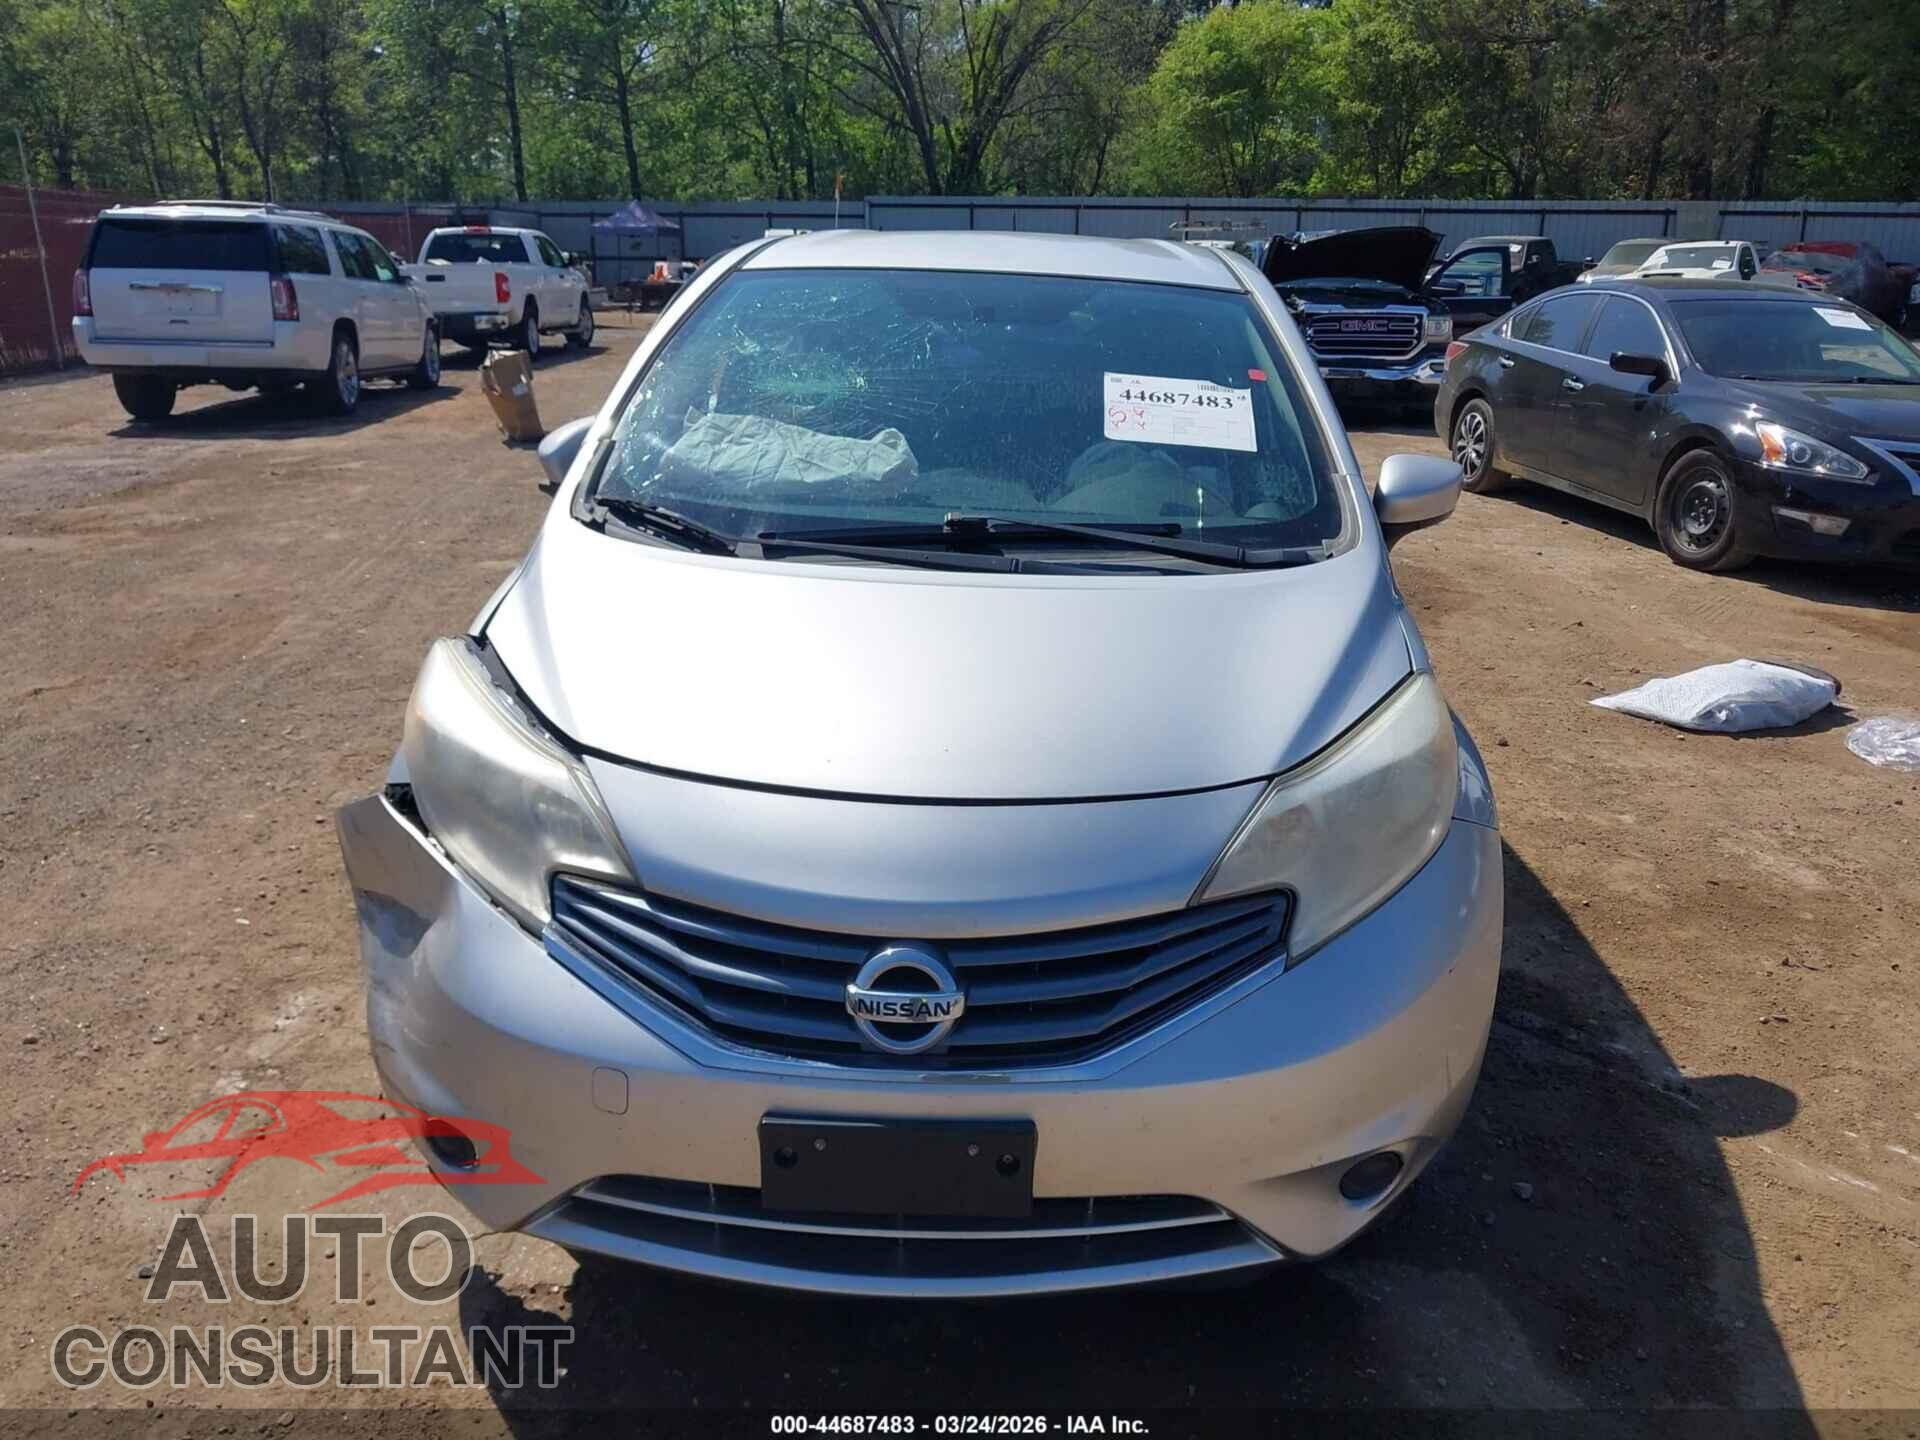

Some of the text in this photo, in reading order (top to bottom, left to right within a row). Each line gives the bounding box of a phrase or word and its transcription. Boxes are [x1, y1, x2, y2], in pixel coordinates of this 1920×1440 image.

[1341, 320, 1389, 332] GMC
[1119, 388, 1234, 410] 44687483
[857, 998, 951, 1018] NISSAN
